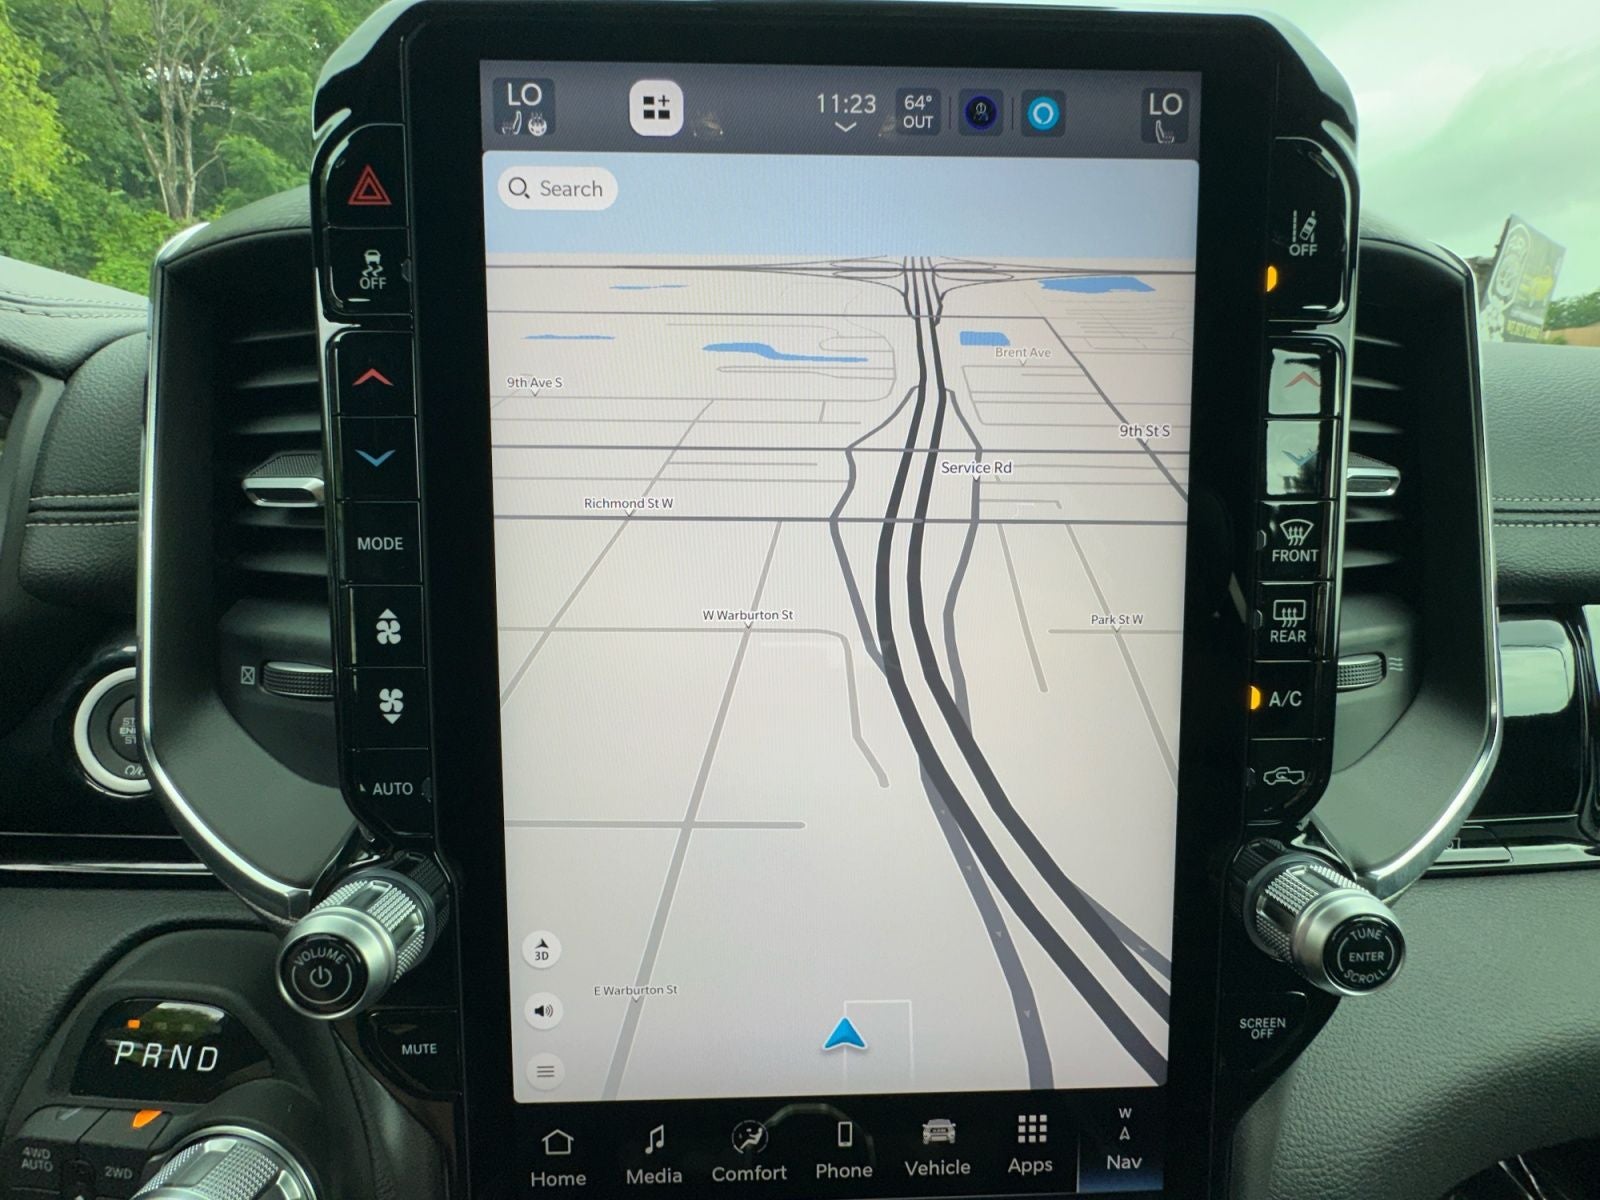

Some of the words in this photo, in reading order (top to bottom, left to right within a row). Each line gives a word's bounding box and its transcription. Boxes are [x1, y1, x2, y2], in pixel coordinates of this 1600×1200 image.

[506, 82, 543, 107] LO
[816, 93, 877, 115] 11:23
[1148, 92, 1183, 116] LO
[902, 115, 934, 130] OUT
[539, 180, 604, 198] Search
[1288, 243, 1318, 257] OFF
[359, 277, 387, 290] OFF
[995, 347, 1028, 358] Brent
[1029, 347, 1052, 358] Ave
[507, 377, 528, 389] 9th
[530, 377, 553, 388] Ave
[555, 377, 563, 389] S
[1119, 424, 1143, 438] 9th
[1145, 424, 1160, 437] St
[1161, 424, 1171, 438] S
[941, 461, 992, 475] Service
[994, 461, 1012, 474] Rd
[584, 497, 645, 510] Richmond
[647, 497, 661, 510] St
[661, 498, 674, 509] W
[357, 537, 404, 551] MODE
[1272, 549, 1319, 562] FRONT
[703, 610, 715, 621] W
[716, 609, 779, 621] Warburton
[781, 609, 794, 620] St
[1091, 614, 1117, 625] Park
[1118, 614, 1131, 625] St
[1131, 614, 1144, 625] W
[1270, 629, 1307, 643] REAR
[1268, 690, 1303, 708] A/C
[372, 782, 414, 796] AUTO
[1350, 927, 1382, 941] TUNE
[294, 947, 346, 967] VOLUME
[534, 951, 549, 961] 3D
[1349, 951, 1385, 962] ENTER
[1343, 969, 1388, 984] SCROLL
[594, 986, 601, 996] E
[603, 984, 664, 996] Warburton
[666, 984, 678, 995] St
[1239, 1017, 1287, 1029] SCREEN
[1250, 1028, 1275, 1040] OFF
[401, 1043, 438, 1055] MUTE
[1119, 1108, 1132, 1119] W
[21, 1146, 51, 1160] 4WD
[21, 1159, 54, 1172] AUTO
[905, 1159, 971, 1176] Vehicle
[1007, 1158, 1053, 1175] Apps
[1106, 1155, 1142, 1170] Nav
[104, 1166, 133, 1180] 2WD
[626, 1167, 683, 1184] Media
[712, 1164, 788, 1182] Comfort
[816, 1163, 873, 1179] Phone
[530, 1171, 587, 1188] Home
